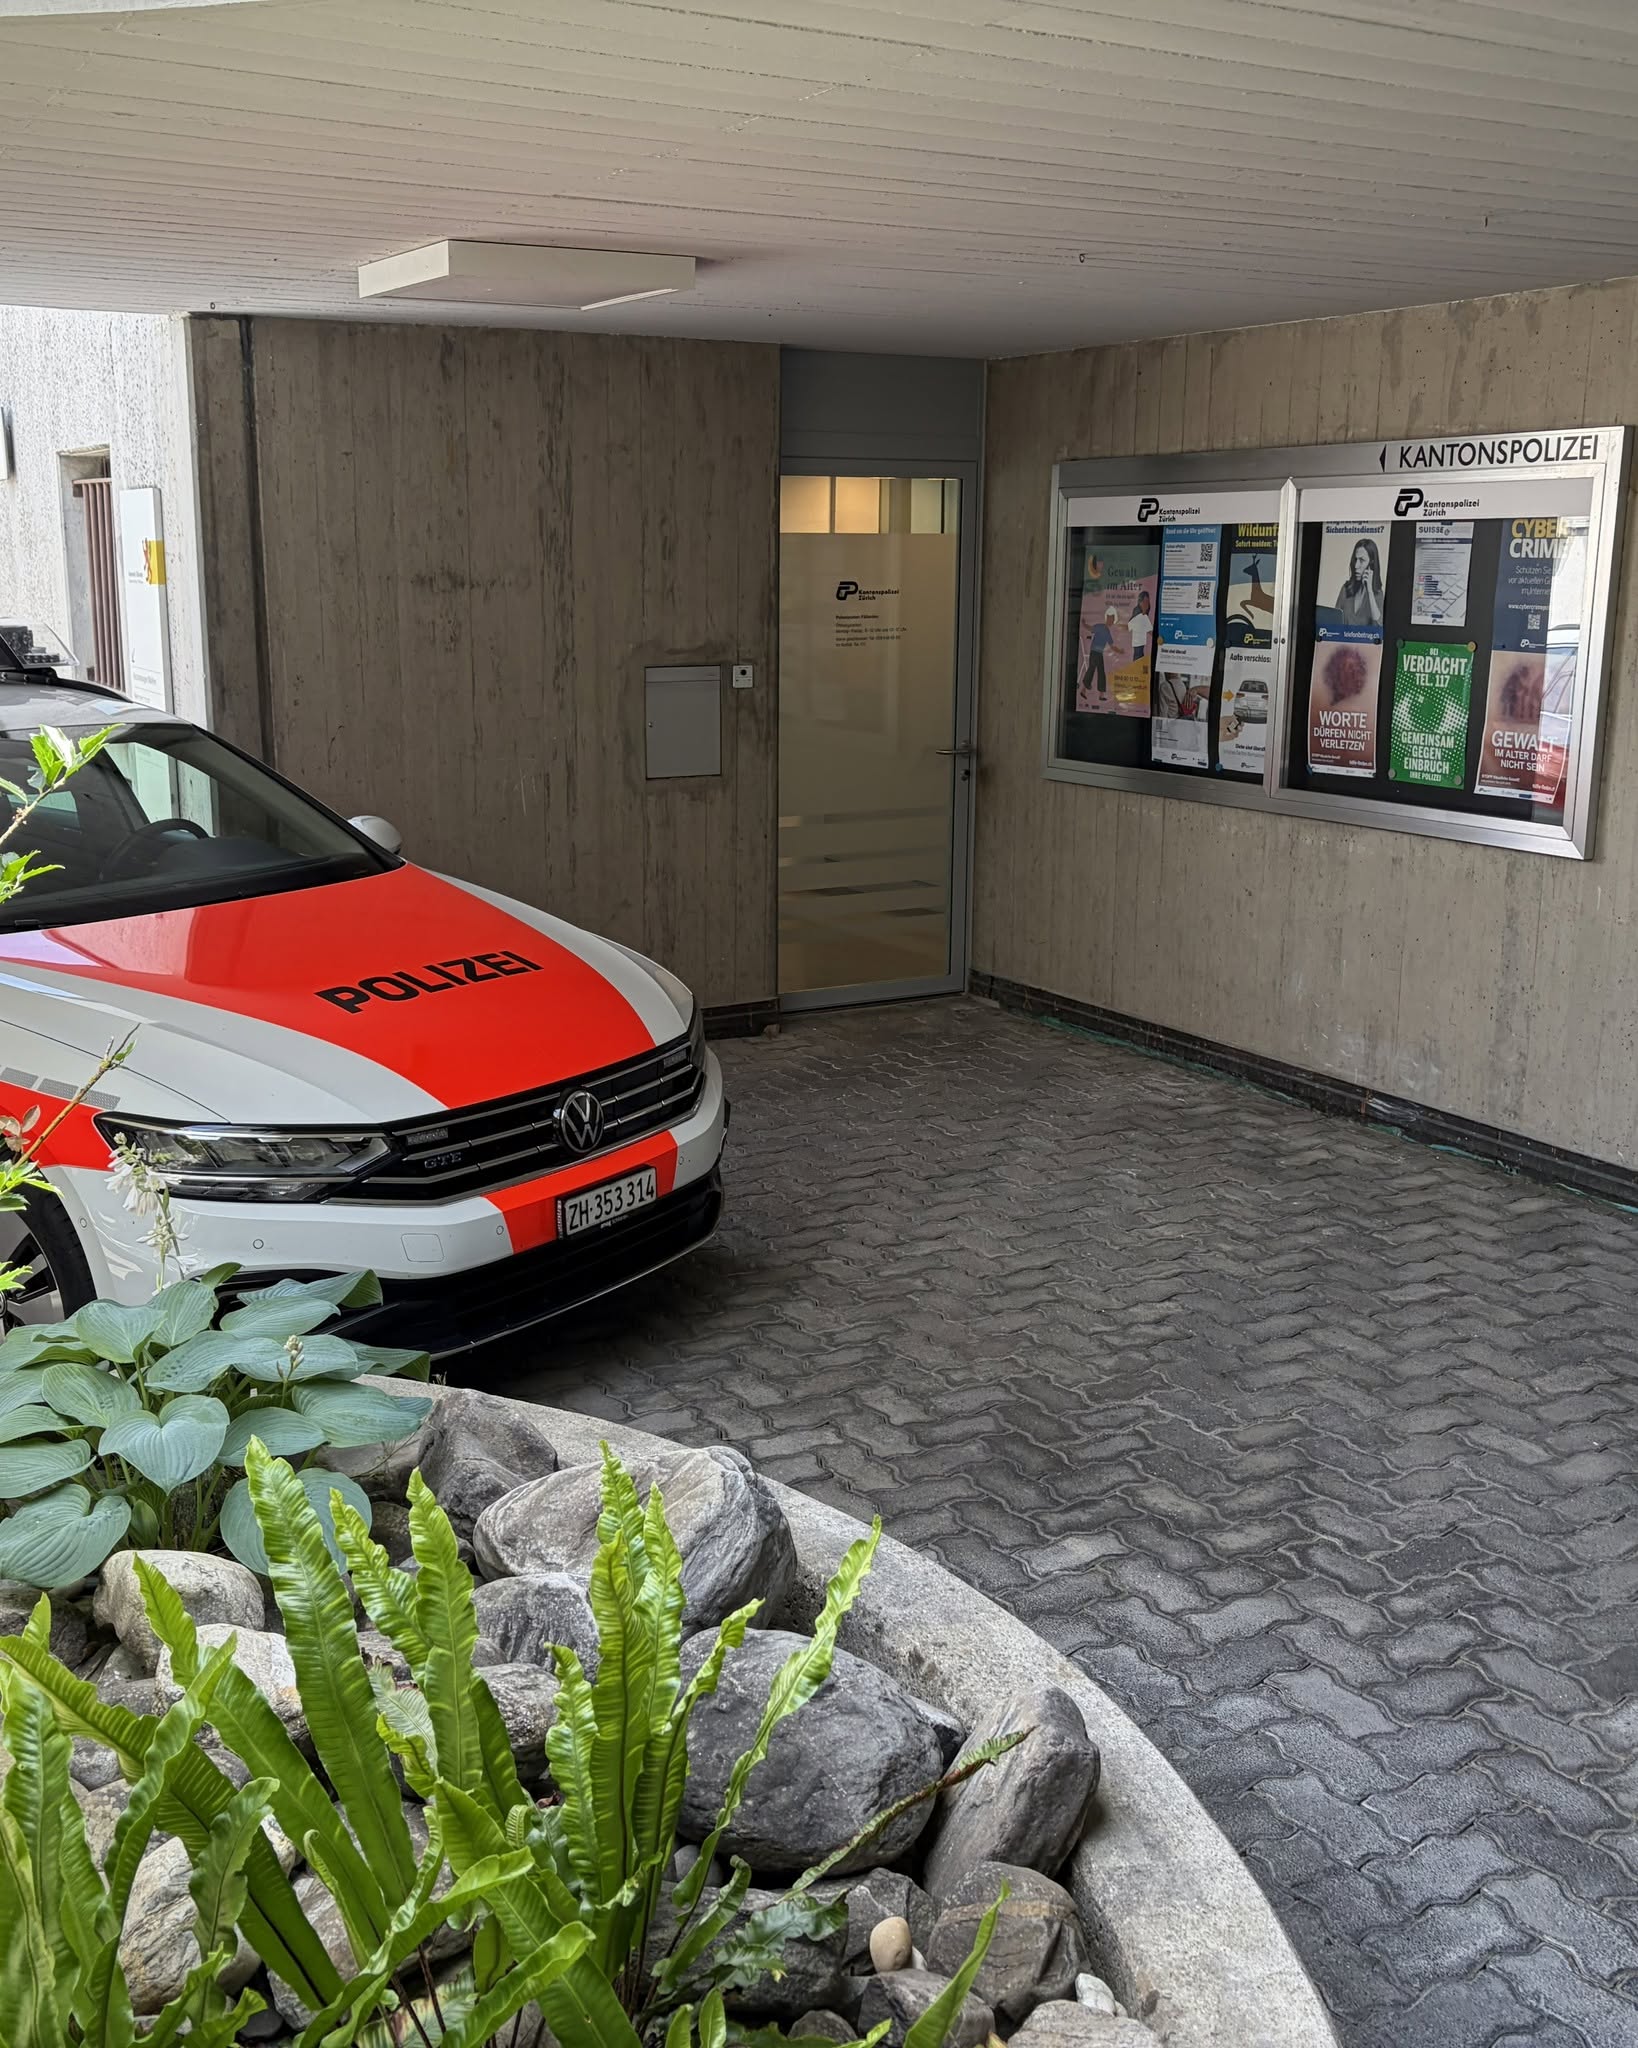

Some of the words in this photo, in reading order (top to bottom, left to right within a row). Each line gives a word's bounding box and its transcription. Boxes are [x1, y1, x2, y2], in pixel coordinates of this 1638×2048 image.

[1399, 434, 1599, 468] KANTONSPOLIZEI
[1159, 507, 1200, 516] Kantonspolizei
[1424, 499, 1480, 510] Kantonspolizei
[1423, 508, 1446, 516] Zürich
[1238, 523, 1278, 537] Wildunf
[1326, 526, 1385, 534] Sicherheitsdienst?
[1230, 652, 1244, 661] Auto
[1244, 654, 1272, 663] verschlos
[1402, 654, 1468, 676] VERDACHT
[1416, 672, 1433, 687] TEL.
[1434, 674, 1450, 688] 117
[1319, 710, 1368, 728] WORTE
[1314, 726, 1347, 738] DÜRFEN
[1348, 729, 1372, 740] NICHT
[1401, 731, 1455, 749] GEMEINSAM
[1320, 738, 1366, 751] VERLETZEN
[1491, 730, 1558, 753] GEWALT
[1412, 744, 1442, 760] GEGEN
[1494, 748, 1504, 758] IM
[1505, 749, 1530, 760] ALTER
[1530, 752, 1553, 762] DARF
[1403, 757, 1450, 774] EINBRUCH
[1500, 759, 1525, 770] NICHT
[1526, 762, 1546, 772] SEIN
[1421, 773, 1442, 782] POLIZEI
[313, 950, 544, 1014] POLIZEI
[424, 1152, 462, 1169] GTE
